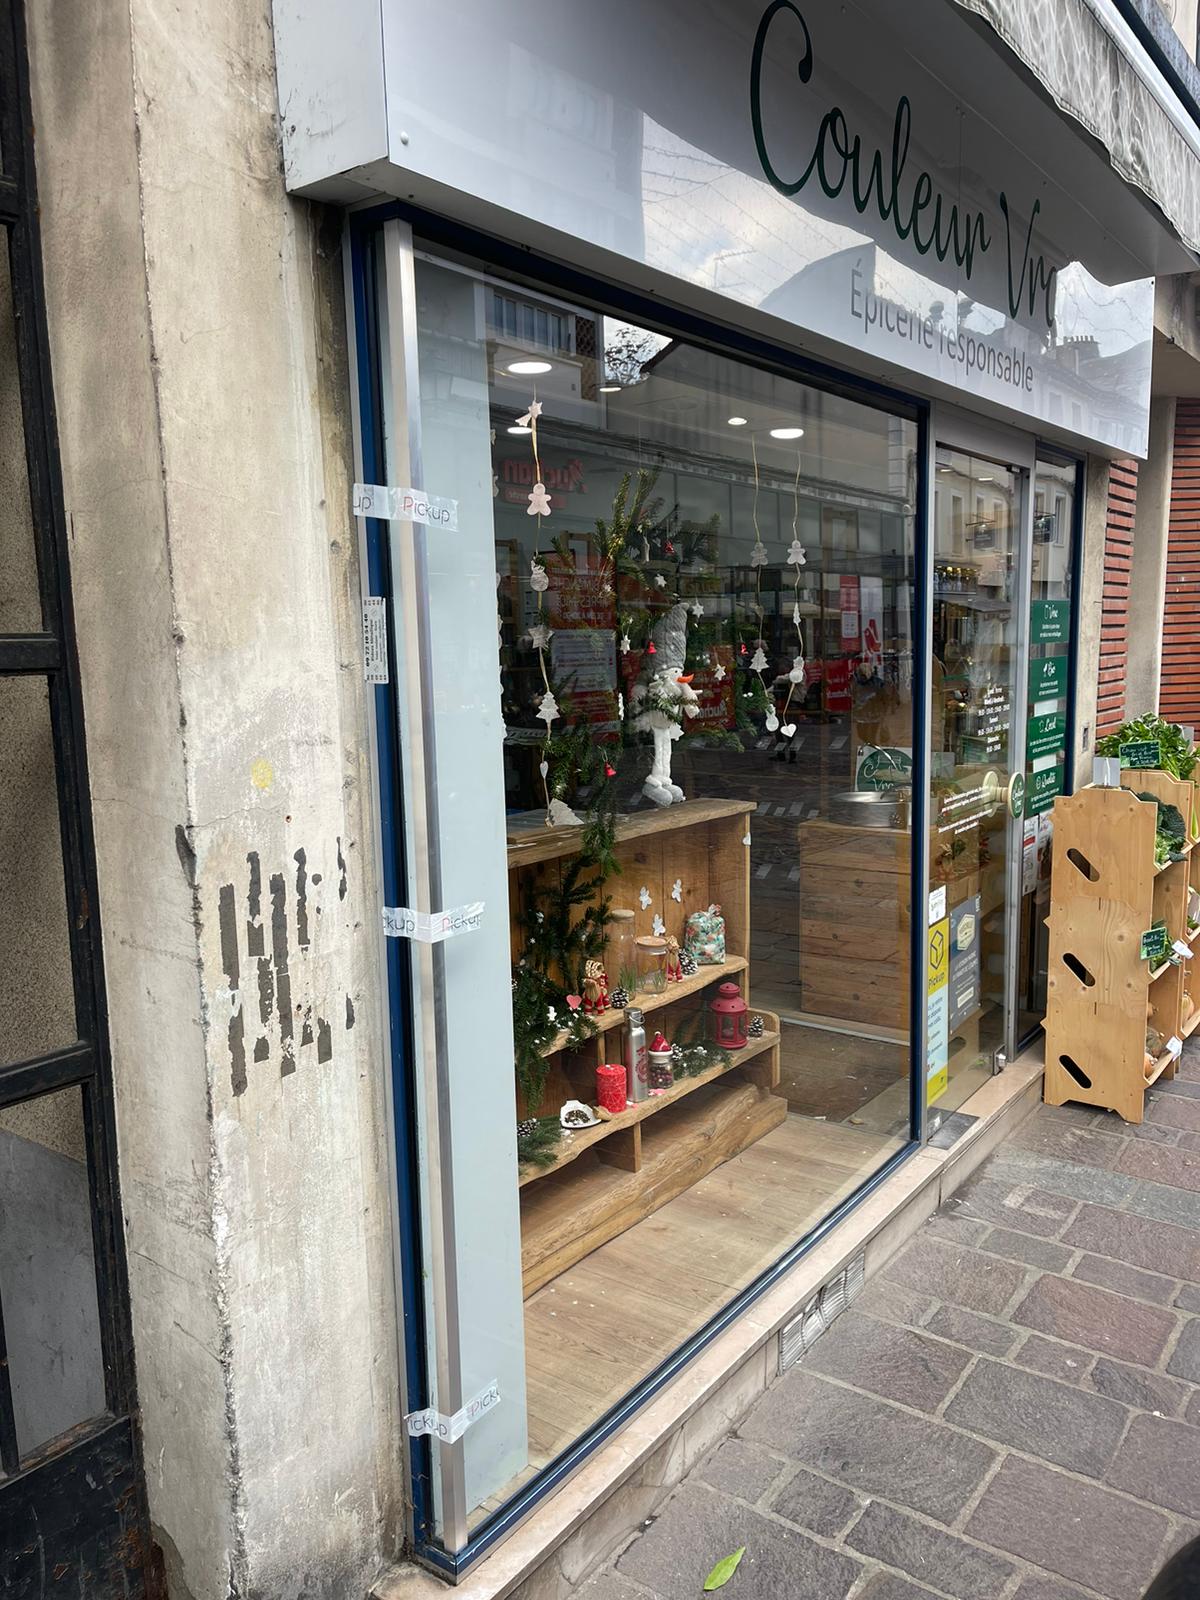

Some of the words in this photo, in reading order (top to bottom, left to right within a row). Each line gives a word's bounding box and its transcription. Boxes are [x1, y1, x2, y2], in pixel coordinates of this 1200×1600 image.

[750, 0, 992, 281] Couleur
[1000, 190, 1058, 328] Vr
[851, 258, 934, 349] Épicerie
[939, 322, 1034, 392] responsable
[402, 495, 450, 525] Pickup
